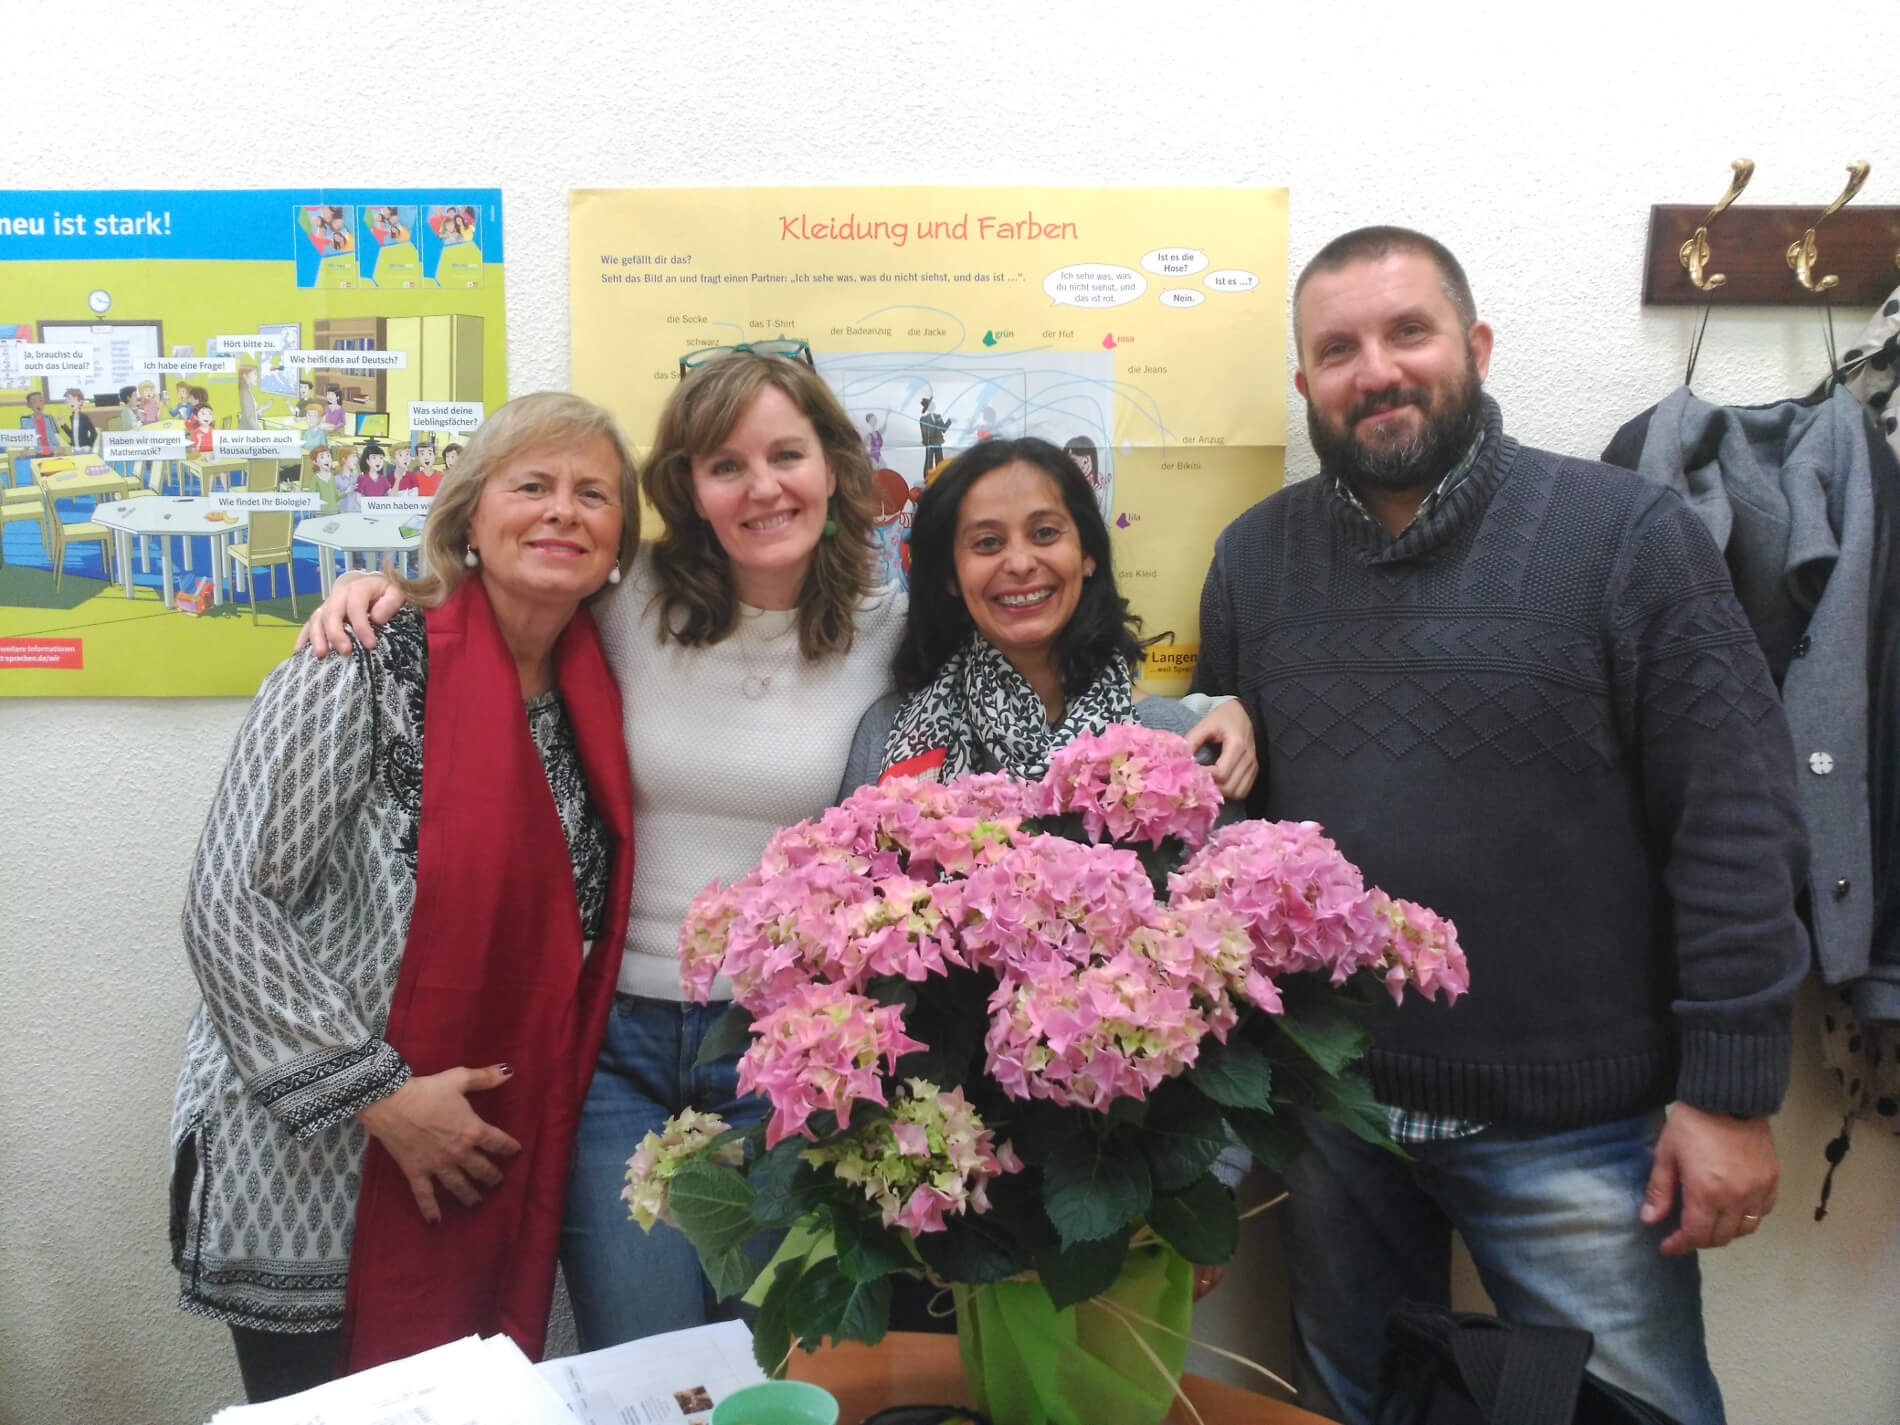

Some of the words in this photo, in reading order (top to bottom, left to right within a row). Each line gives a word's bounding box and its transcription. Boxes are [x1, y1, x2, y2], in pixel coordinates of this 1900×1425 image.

[53, 211, 86, 236] ist
[94, 211, 171, 236] stark!
[779, 213, 908, 247] Kleidung
[917, 213, 968, 240] und
[977, 211, 1078, 240] Farben
[601, 255, 618, 264] Wie
[621, 255, 652, 266] gefällt
[654, 255, 667, 264] dir
[670, 255, 692, 264] das?
[1157, 253, 1168, 261] Ist
[1181, 253, 1194, 261] die
[1163, 264, 1188, 272] Hose?
[601, 274, 622, 283] Seht
[625, 274, 641, 283] das
[644, 274, 662, 283] Bild
[680, 274, 697, 283] und
[700, 274, 721, 285] fragt
[724, 274, 748, 283] einen
[751, 274, 787, 283] Partner:
[813, 274, 834, 282] sehe
[837, 275, 857, 284] was,
[879, 273, 892, 282] du
[894, 273, 918, 282] nicht
[920, 273, 950, 283] siehst,
[953, 273, 971, 282] und
[974, 273, 990, 282] das
[993, 273, 1005, 282] ist
[1061, 271, 1074, 280] Ich
[1076, 272, 1095, 280] sehe
[1116, 272, 1132, 280] was
[1215, 277, 1225, 285] Ist
[1056, 283, 1067, 291] du
[1069, 283, 1089, 291] nicht
[1119, 283, 1136, 291] und
[1075, 295, 1089, 303] das
[1091, 295, 1101, 303] ist
[1103, 295, 1116, 303] rot.
[1173, 294, 1195, 303] Nein.
[666, 314, 680, 324] die
[682, 314, 708, 324] Socke
[749, 319, 765, 328] das
[830, 327, 843, 336] der
[846, 327, 893, 337] Badeanzug
[907, 328, 921, 336] die
[922, 328, 947, 336] Jacke
[995, 329, 1014, 338] grün
[1042, 330, 1056, 338] der
[1059, 330, 1074, 338] Hut
[223, 340, 241, 349] Hört
[243, 340, 261, 349] bitte
[263, 340, 276, 349] zu.
[686, 338, 720, 346] schwarz
[24, 350, 34, 360] Ja,
[36, 350, 71, 359] brauchst
[72, 350, 83, 359] du
[290, 355, 305, 364] Wie
[307, 355, 327, 364] heißt
[329, 355, 344, 364] das
[346, 355, 360, 364] auf
[362, 355, 398, 365] Deutsch?
[24, 361, 43, 370] auch
[45, 361, 60, 370] das
[62, 361, 90, 370] Lineal?
[143, 361, 156, 370] Ich
[158, 361, 178, 370] habe
[180, 362, 197, 370] eine
[199, 361, 226, 372] Frage!
[1127, 366, 1141, 374] die
[1143, 366, 1168, 374] Jeans
[653, 371, 669, 380] das
[413, 407, 429, 415] Was
[431, 407, 448, 415] sind
[450, 407, 473, 415] deine
[413, 417, 478, 427] Lieblingsfächer?
[109, 436, 133, 446] Haben
[134, 437, 149, 446] wir
[150, 437, 181, 448] morgen
[219, 435, 230, 445] Ja,
[231, 436, 246, 444] wir
[248, 435, 271, 444] haben
[273, 435, 292, 444] auch
[1182, 436, 1196, 444] der
[1198, 436, 1225, 445] Anzug
[110, 447, 161, 456] Mathematik?
[219, 447, 280, 457] Hausaufgaben.
[1161, 462, 1175, 471] der
[1177, 462, 1202, 471] Bikini
[218, 498, 234, 507] Wie
[236, 498, 260, 507] findet
[261, 498, 273, 507] ihr
[275, 498, 311, 509] Biologie?
[367, 502, 391, 510] Wann
[393, 502, 419, 510] haben
[1128, 513, 1141, 521] lila
[1118, 570, 1133, 578] das
[1135, 570, 1157, 578] Kleid
[1152, 651, 1197, 665] Langen
